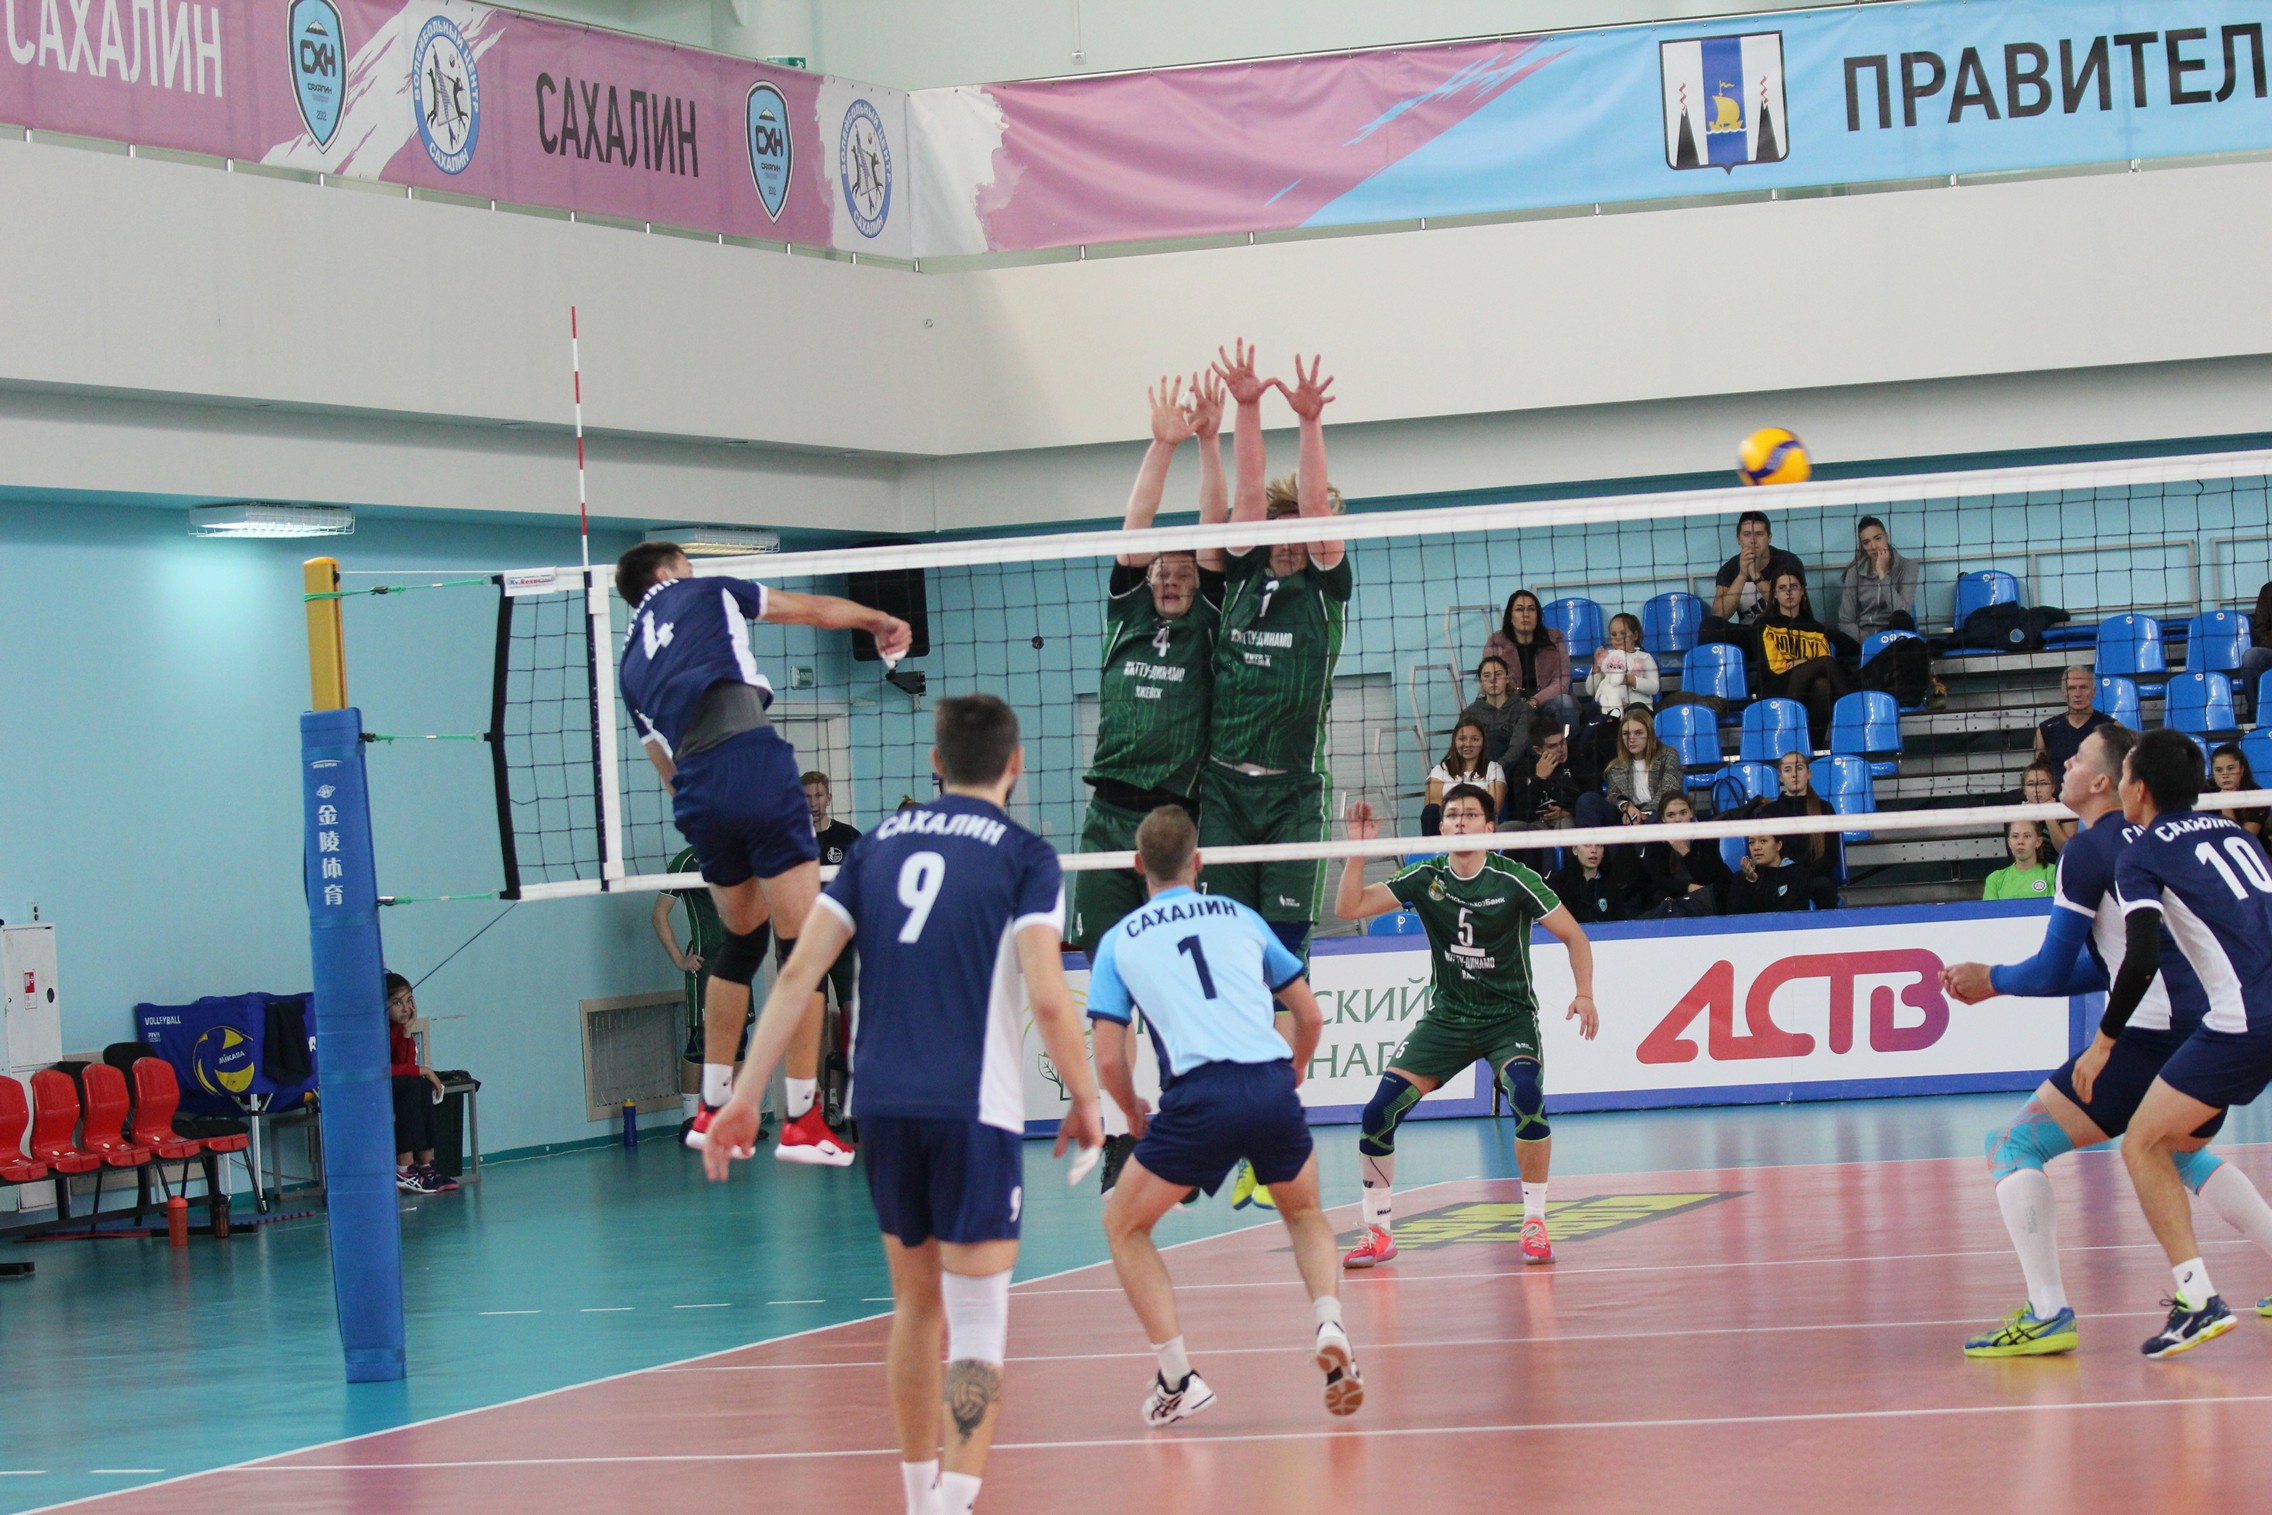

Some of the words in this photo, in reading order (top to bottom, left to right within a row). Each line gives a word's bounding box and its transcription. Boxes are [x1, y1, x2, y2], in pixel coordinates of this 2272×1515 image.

[6, 0, 223, 98] САХАЛИН
[463, 49, 479, 113] ЦЕНТР
[1843, 22, 2269, 132] ПРАВИТЕЛ
[536, 72, 699, 178] САХАЛИН
[429, 142, 469, 171] САХАЛИН
[642, 610, 675, 660] 4
[1152, 626, 1171, 658] 4
[876, 810, 1008, 847] САХАЛИН
[317, 804, 344, 907] 金陵体育
[2195, 836, 2272, 901] 10
[897, 851, 946, 944] 9
[1126, 900, 1238, 939] САХАЛИН
[1458, 907, 1474, 947] 5
[1177, 934, 1218, 1000] 1
[144, 1016, 182, 1026] VOLLEYBALL
[218, 1051, 245, 1065] MIKASA
[1395, 1041, 1410, 1059] 5
